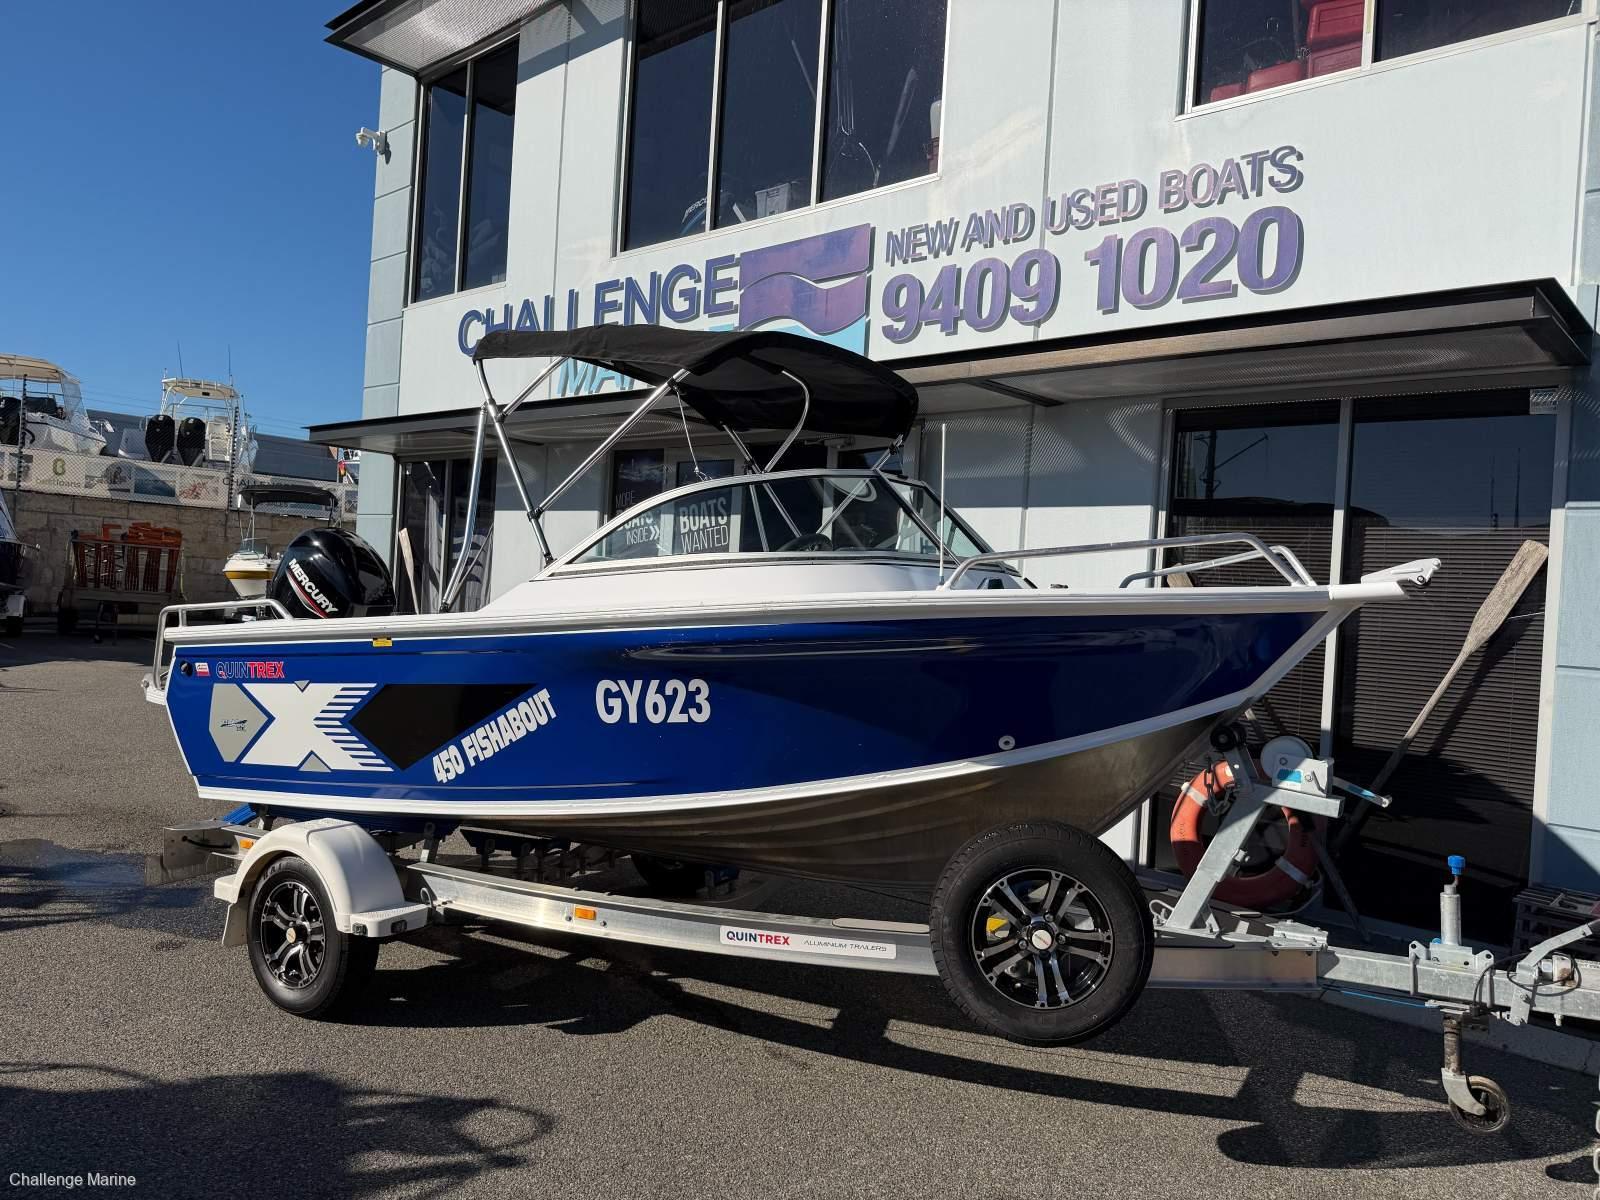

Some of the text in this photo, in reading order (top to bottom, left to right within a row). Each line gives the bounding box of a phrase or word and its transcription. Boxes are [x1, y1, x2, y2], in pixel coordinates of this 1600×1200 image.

[885, 145, 1304, 267] NEW AND USED BOATS
[881, 205, 1304, 344] 9409 1020
[626, 526, 649, 545] INSIDE
[679, 497, 728, 534] BOATS
[681, 525, 729, 553] WANTED
[288, 558, 339, 613] MERCURY
[216, 661, 285, 679] QUINTREX
[595, 678, 711, 724] GY623
[432, 688, 557, 784] 450 FISHABOUT
[726, 930, 887, 952] QUINTREX ALUMINIUM TRAILERS
